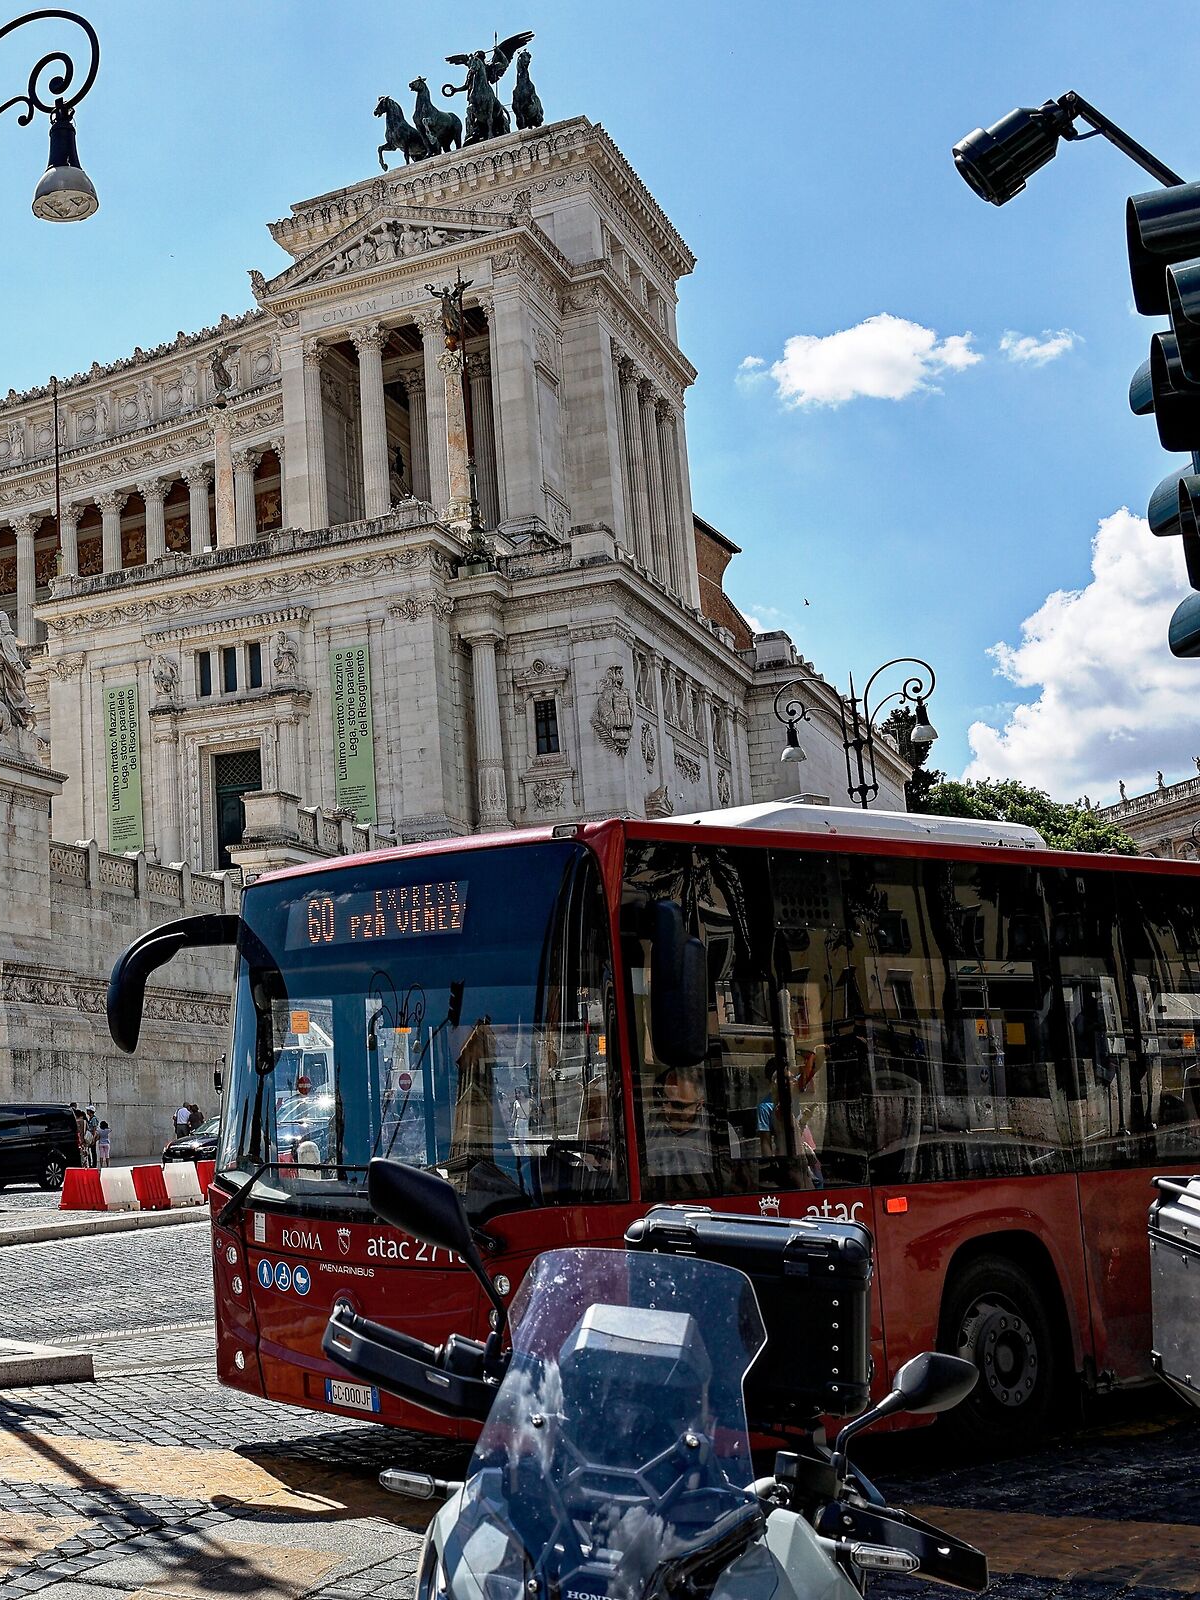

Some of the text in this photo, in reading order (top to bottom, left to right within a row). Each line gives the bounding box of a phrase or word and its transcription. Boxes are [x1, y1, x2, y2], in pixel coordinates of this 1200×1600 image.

[322, 301, 377, 323] CIVIVM
[335, 661, 344, 701] Mazzini
[357, 649, 368, 737] del Risorgimento
[109, 700, 117, 737] Mazzini
[345, 651, 358, 757] Lega, storie parallele
[118, 690, 129, 790] Lega, storie parallele
[128, 688, 137, 770] del Risorgimento
[308, 881, 458, 943] 60 EXPRESS
[351, 913, 385, 939] PZA
[282, 1230, 323, 1250] ROMA
[367, 1236, 410, 1260] atac
